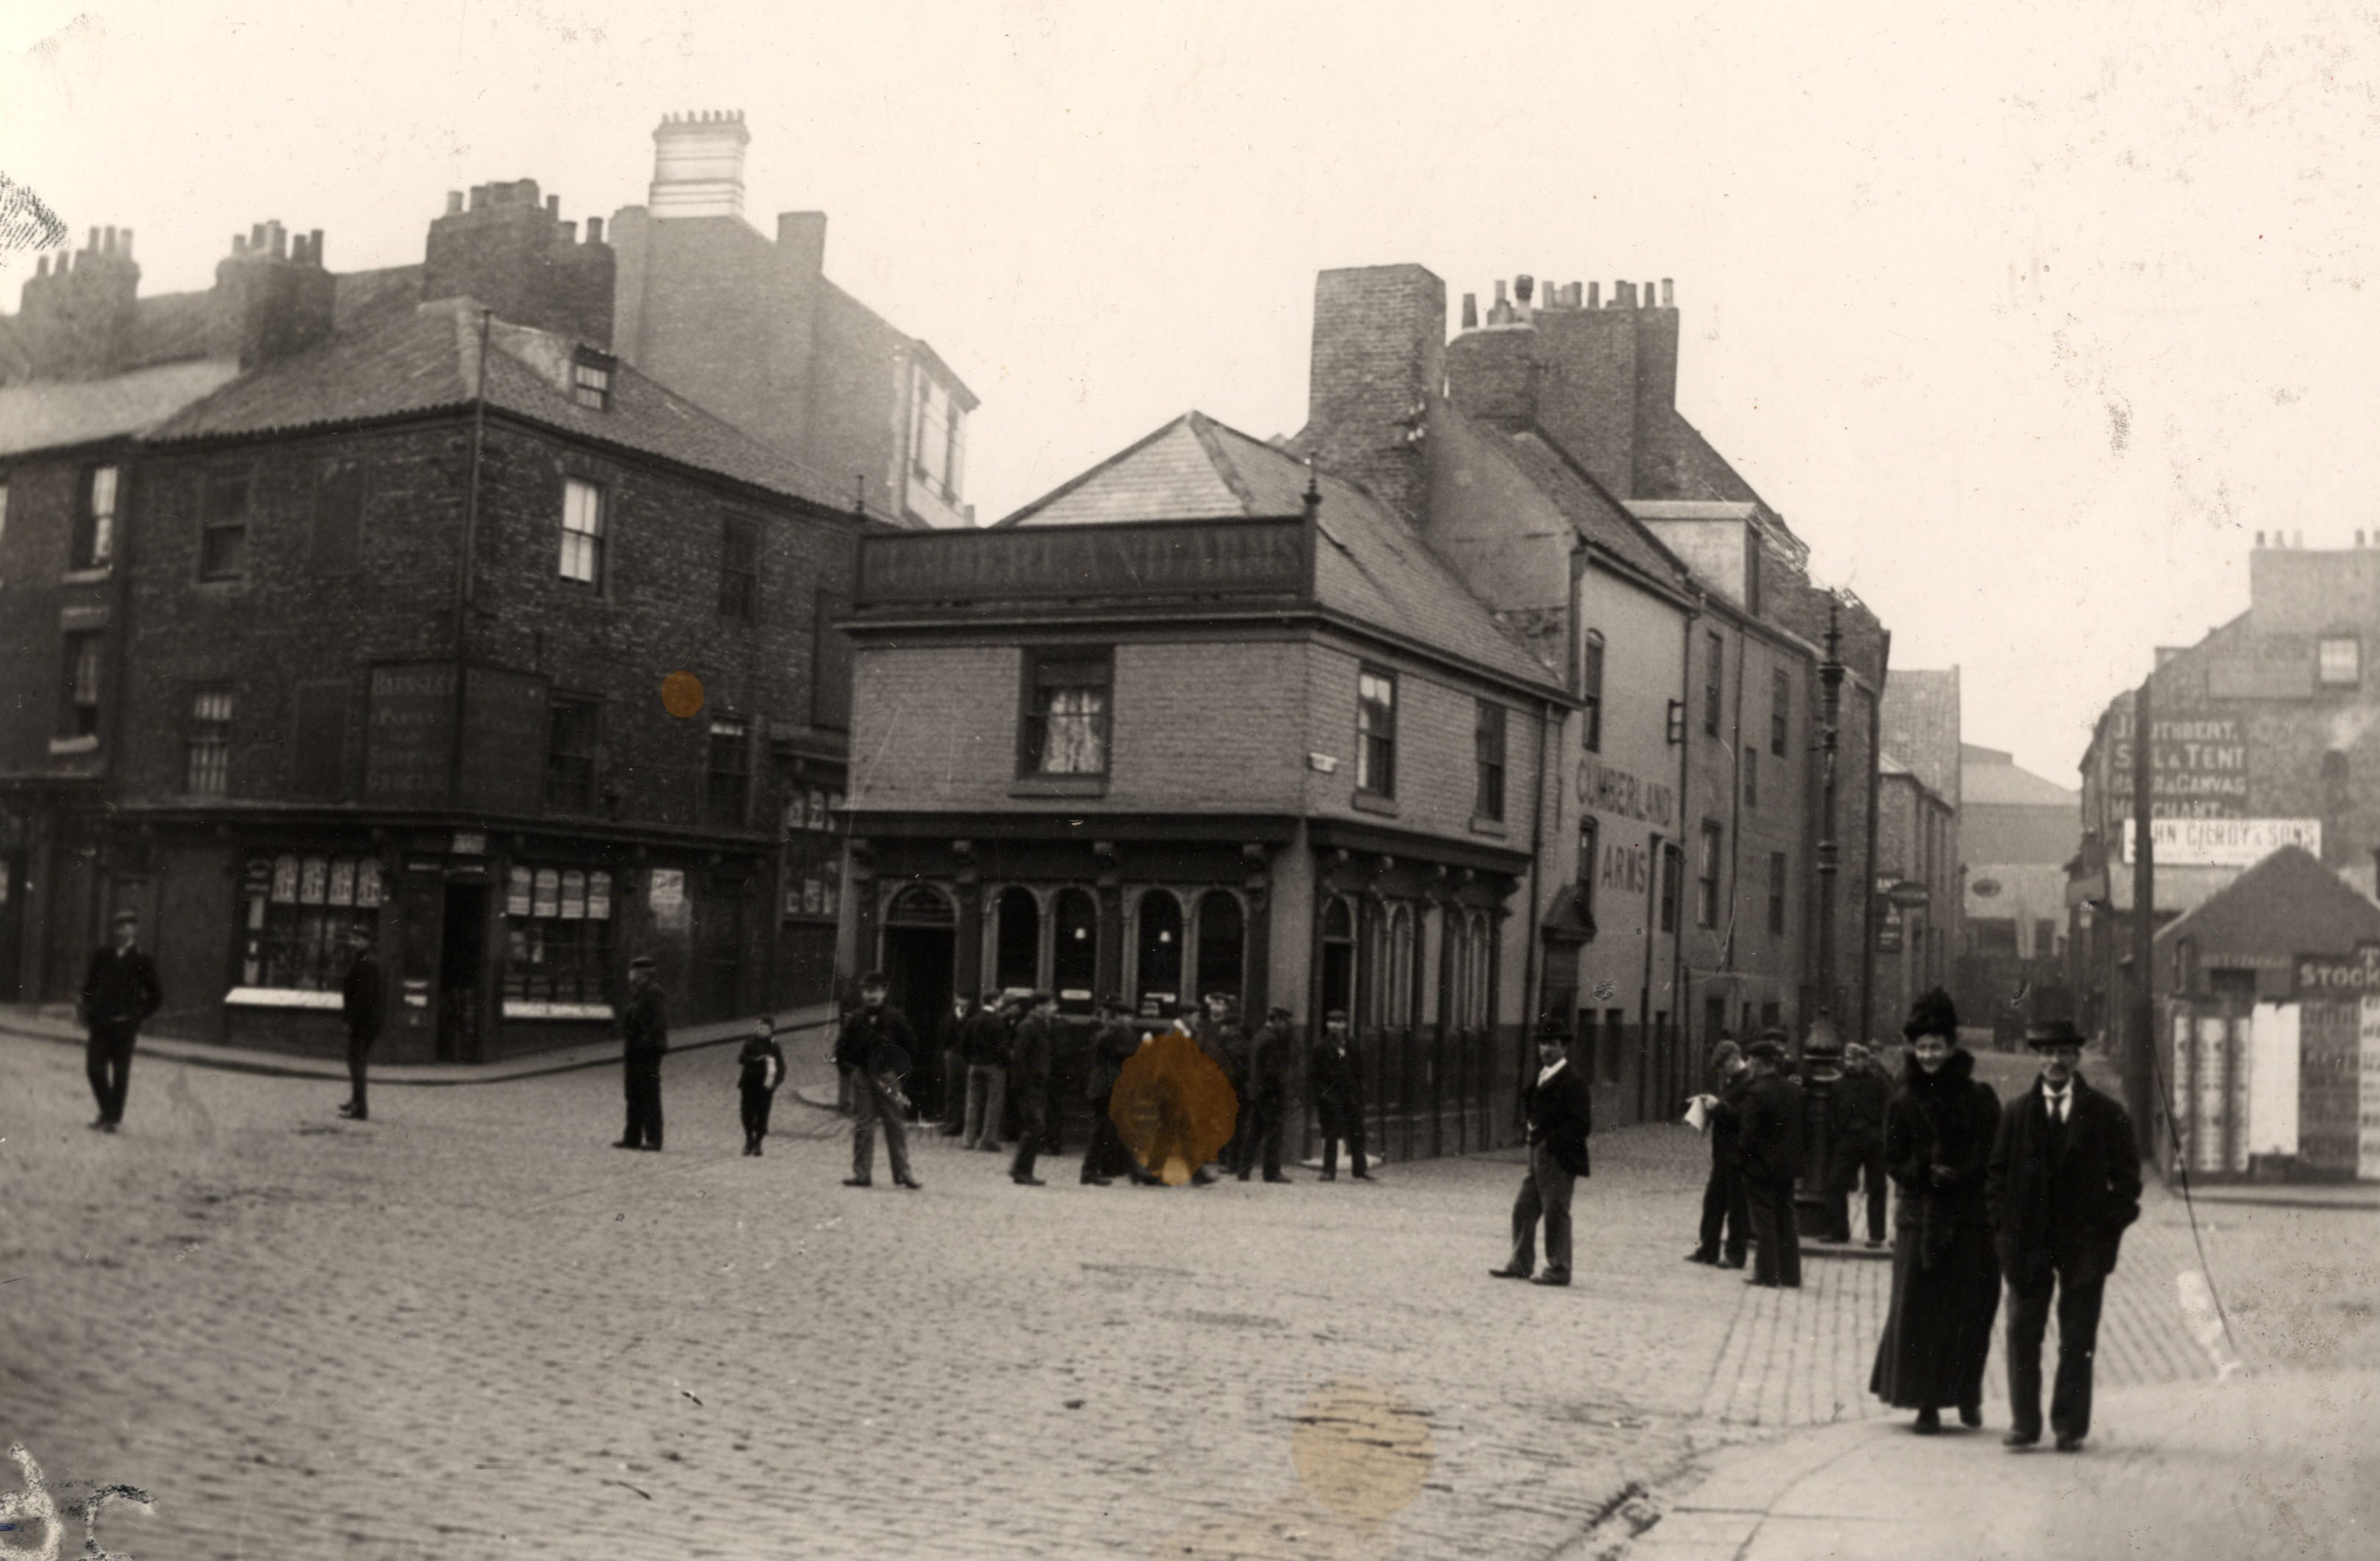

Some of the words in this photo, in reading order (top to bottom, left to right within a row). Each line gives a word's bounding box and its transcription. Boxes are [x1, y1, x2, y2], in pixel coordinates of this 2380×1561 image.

[2114, 742, 2164, 770] SL
[2184, 742, 2245, 770] TENT
[1576, 758, 1673, 828] CUMBERLAND
[2176, 772, 2246, 795] CANVAS
[2111, 798, 2221, 819] MECHANT
[1600, 843, 1647, 894] ARMS
